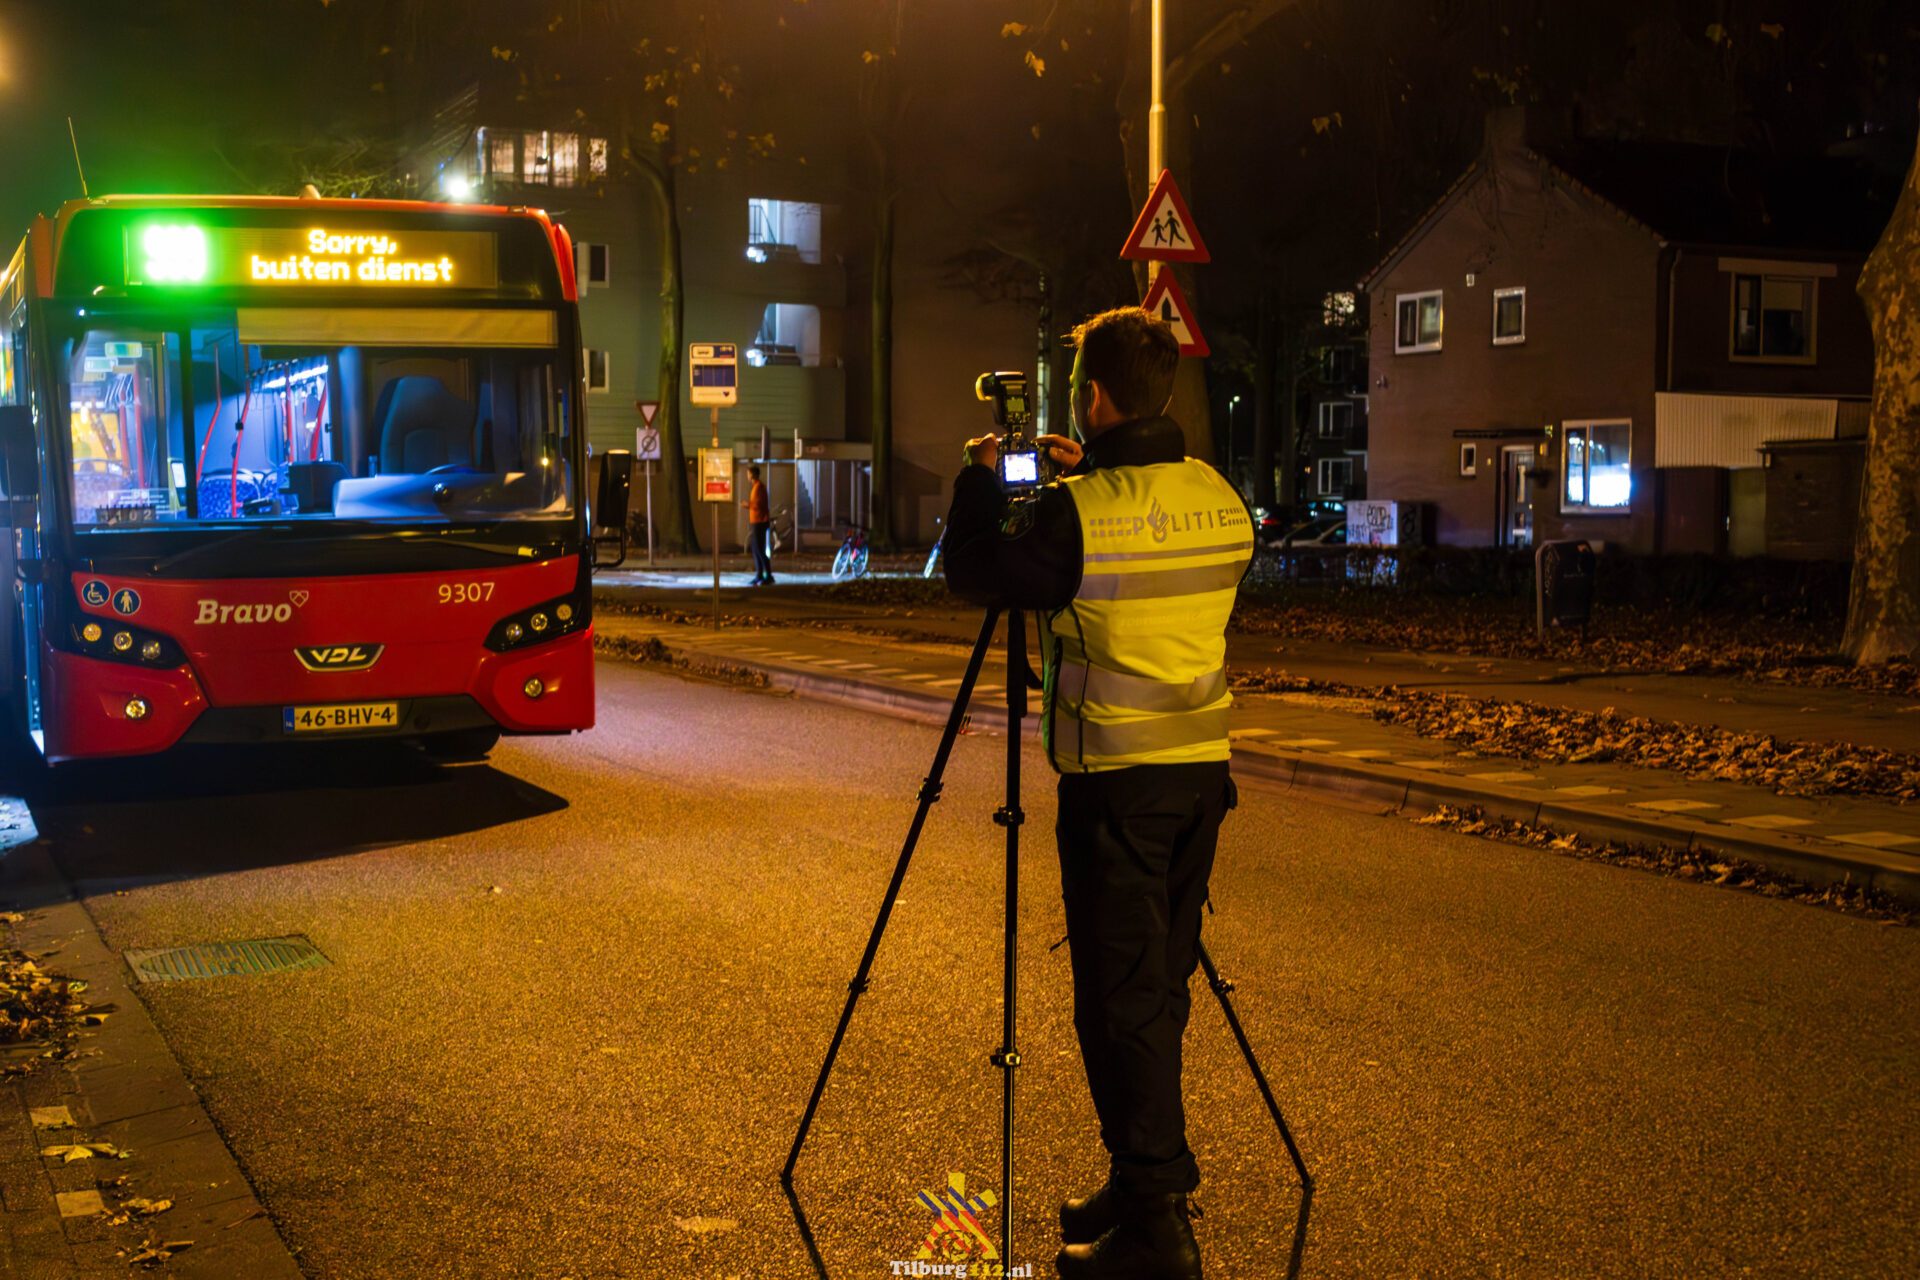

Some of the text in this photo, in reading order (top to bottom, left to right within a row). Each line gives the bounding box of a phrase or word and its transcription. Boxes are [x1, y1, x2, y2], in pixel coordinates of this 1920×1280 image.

[307, 228, 398, 254] Sorry,
[250, 254, 454, 282] buiten dienst
[438, 581, 496, 604] 9307
[193, 599, 292, 625] Bravo
[310, 646, 368, 664] VDL
[300, 706, 392, 727] 46-BHV-4
